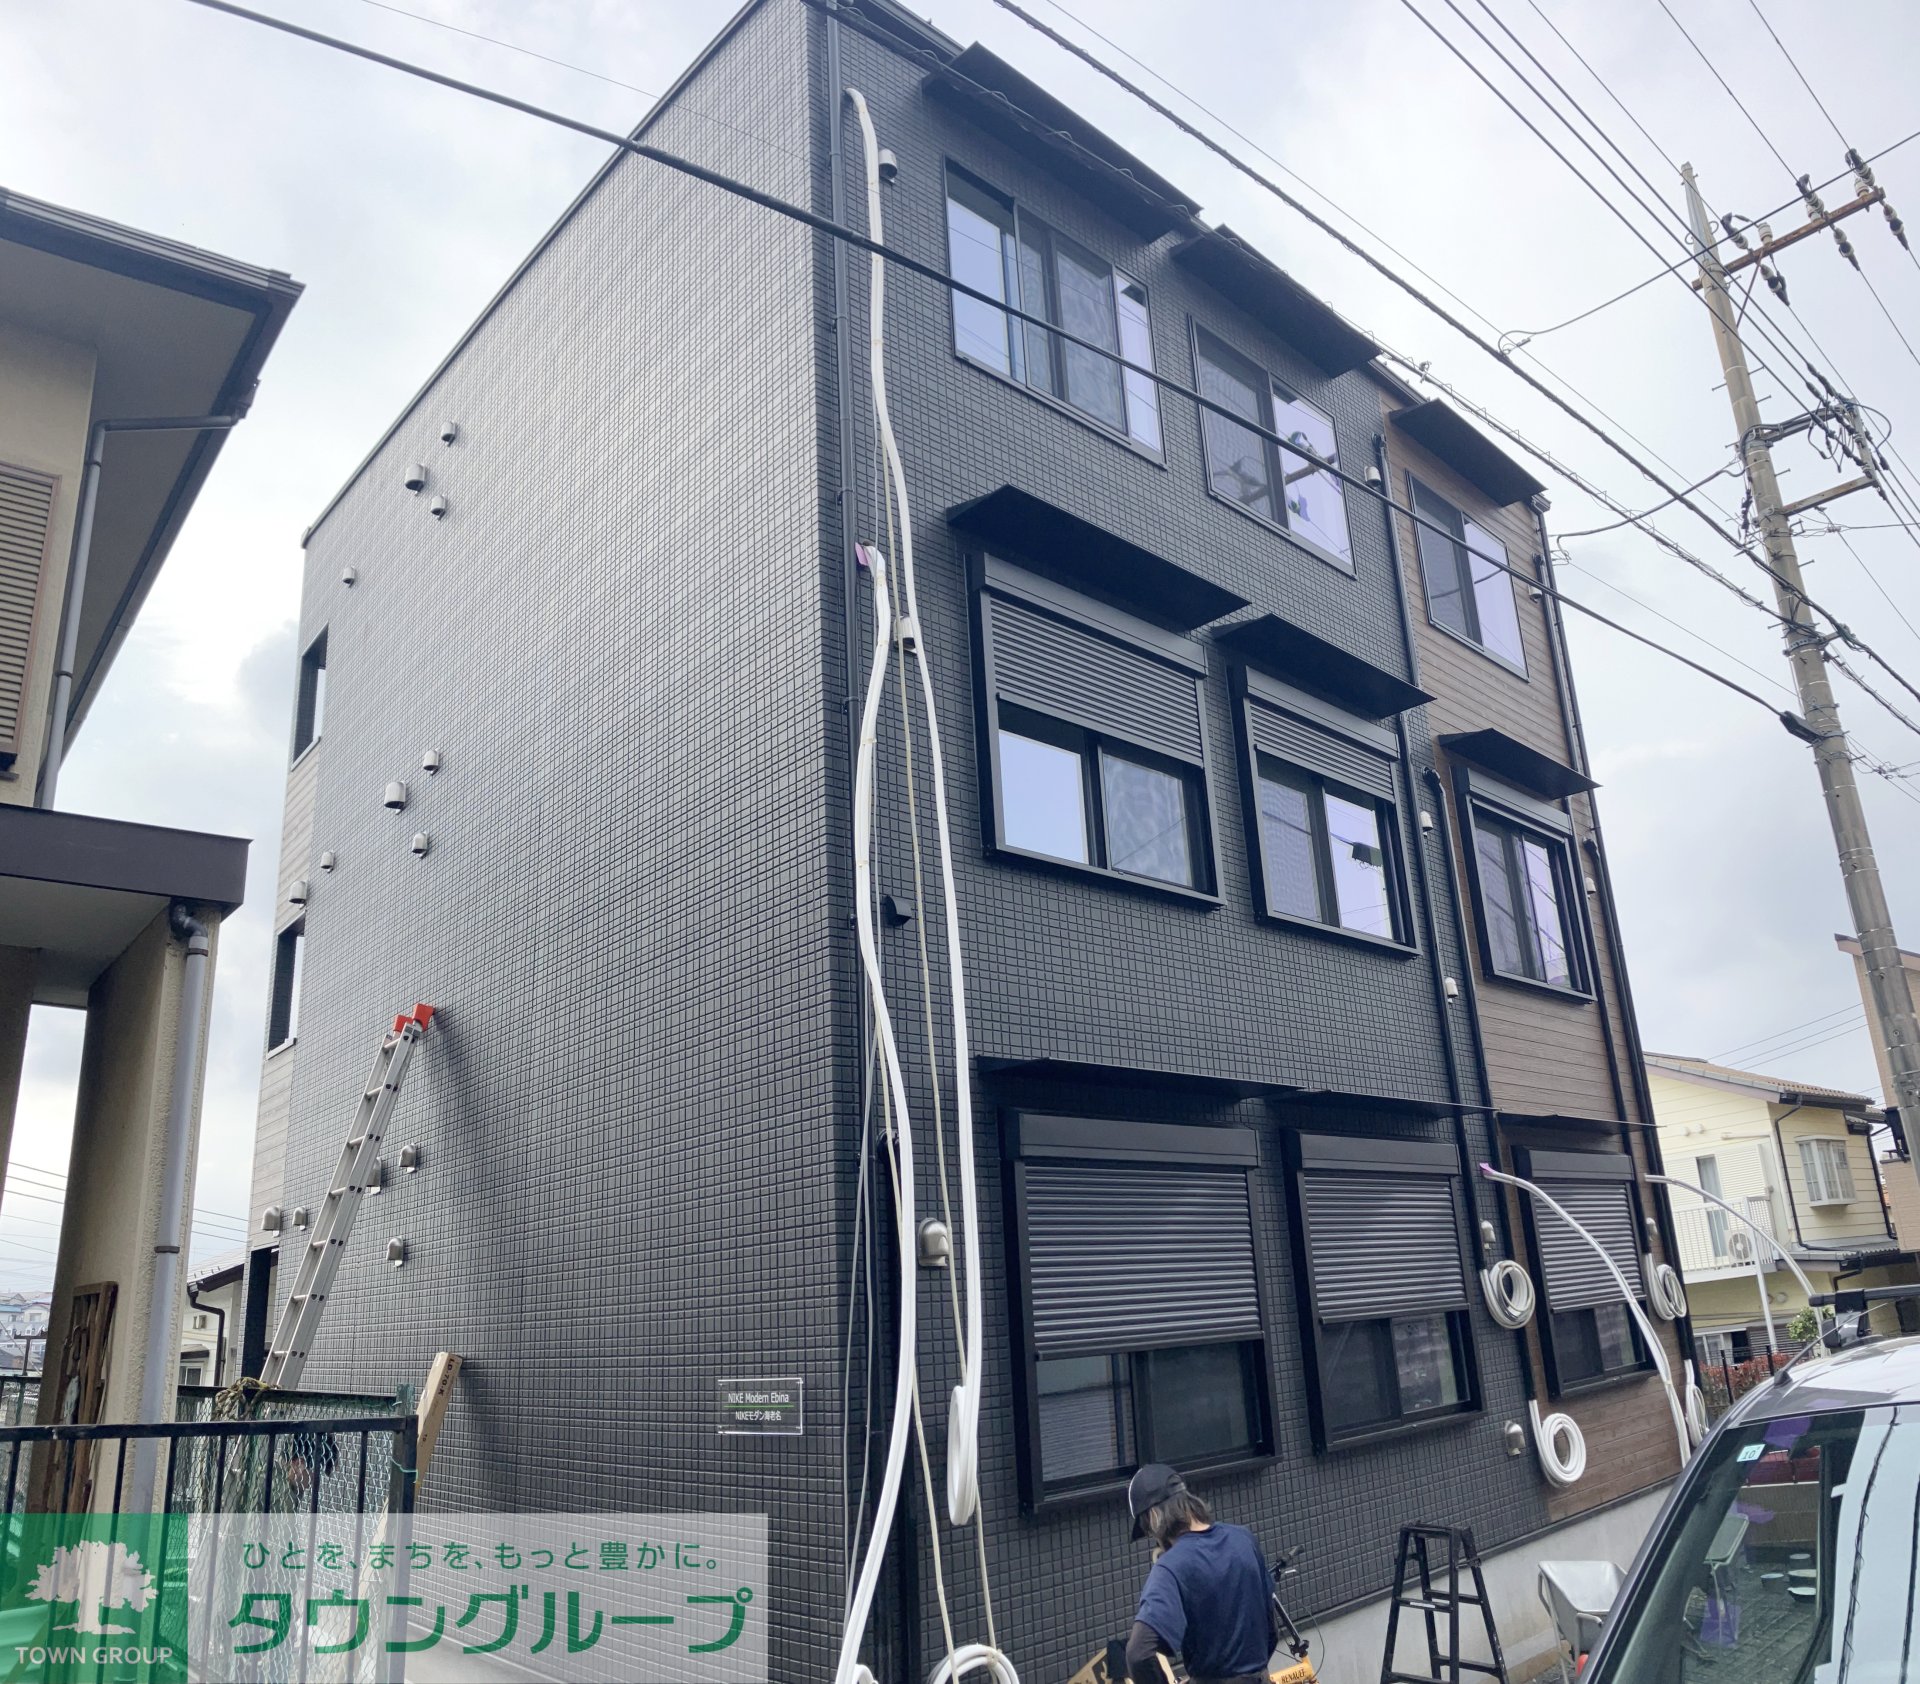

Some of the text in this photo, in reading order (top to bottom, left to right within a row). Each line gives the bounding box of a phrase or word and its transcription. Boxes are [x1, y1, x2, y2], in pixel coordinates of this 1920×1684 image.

[728, 1392, 789, 1404] NIKE Modern Ebina
[735, 1410, 782, 1421] NIKEモダン海老名
